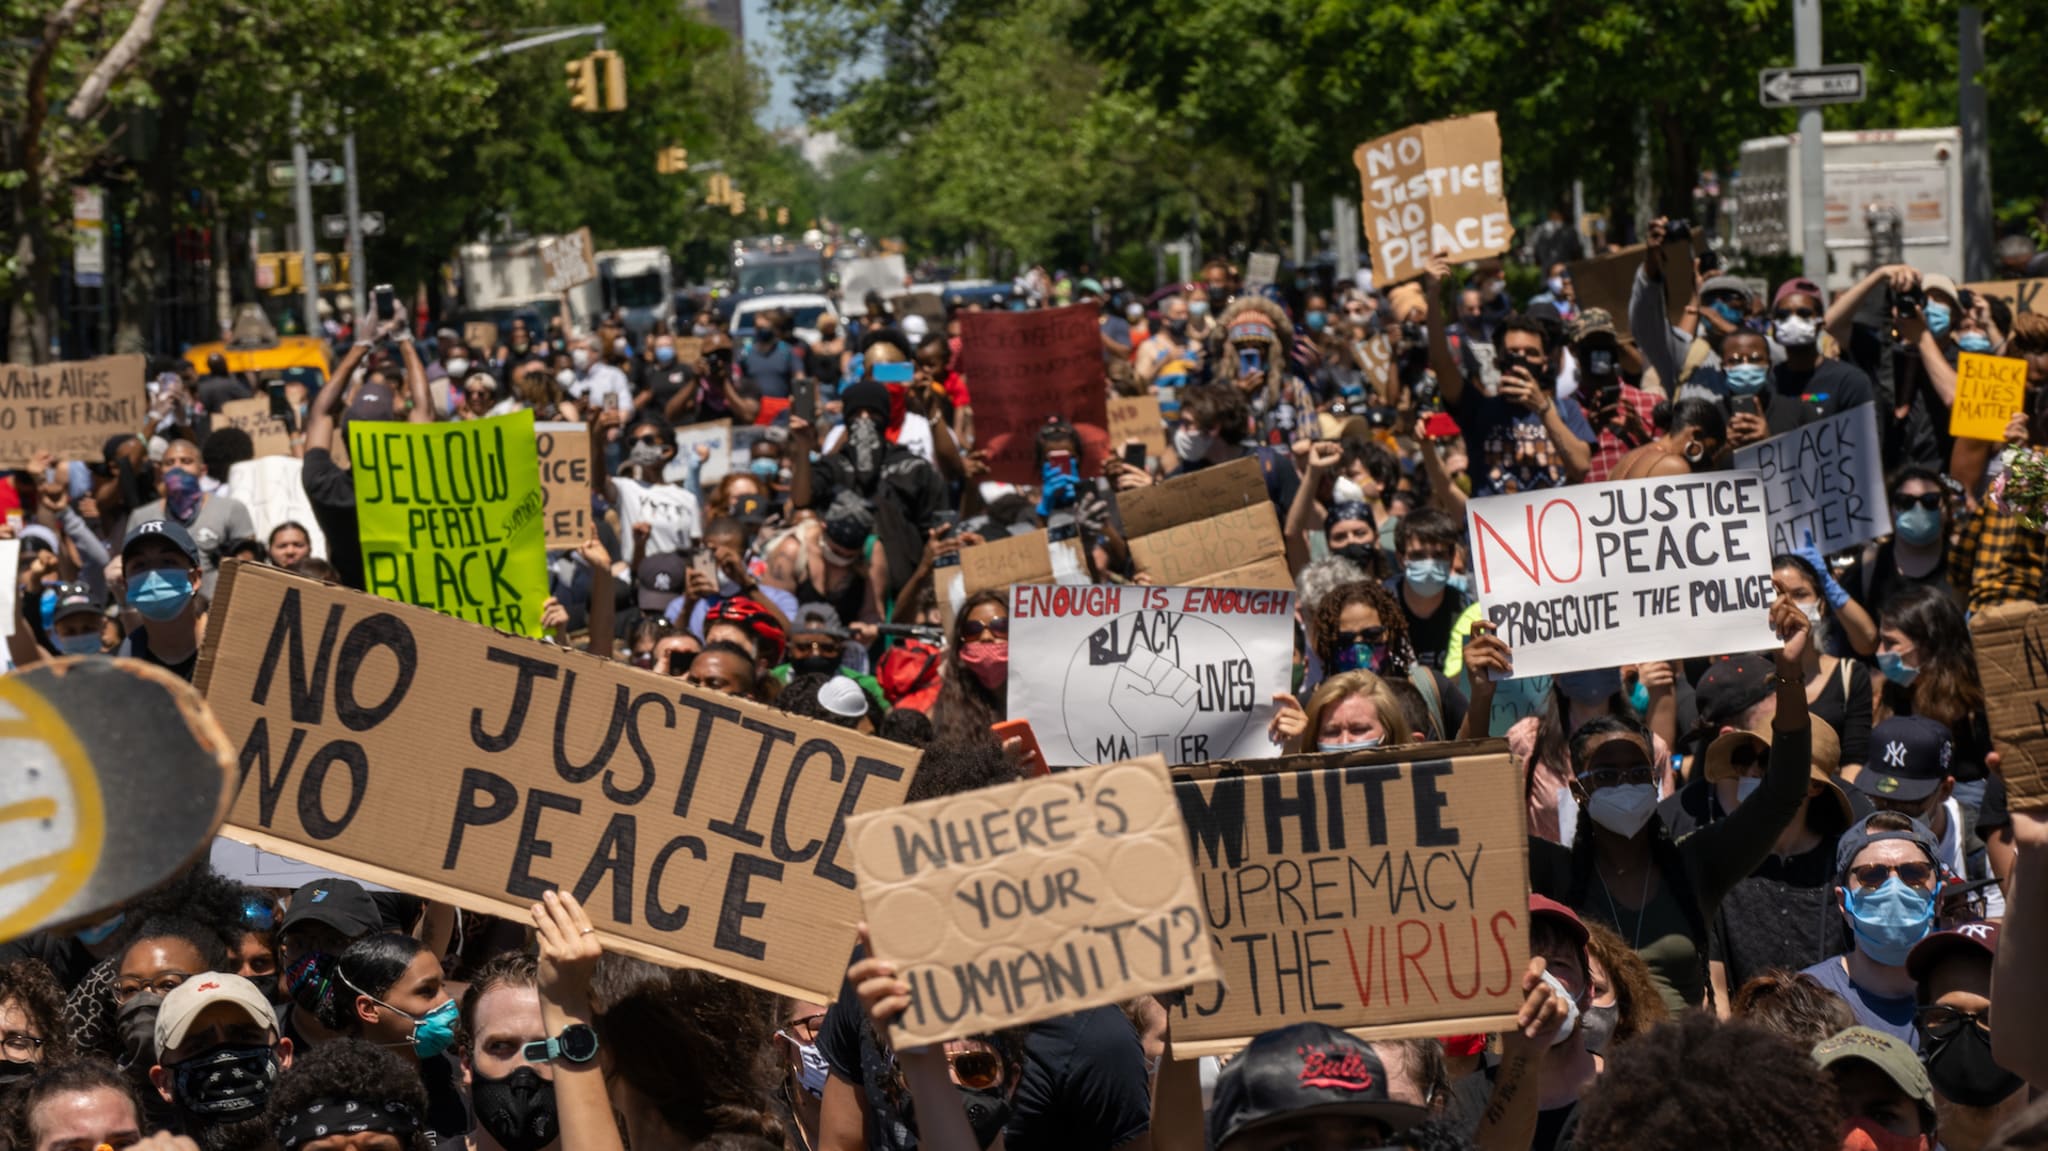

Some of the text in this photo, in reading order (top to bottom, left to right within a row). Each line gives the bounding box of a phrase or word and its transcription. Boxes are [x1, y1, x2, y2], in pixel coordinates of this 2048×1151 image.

[1366, 136, 1422, 177] NO
[1375, 203, 1425, 242] NO
[1380, 212, 1506, 280] PEACE
[58, 368, 111, 398] Allies
[1960, 379, 2016, 403] LIVES
[1965, 360, 2024, 385] BLACK
[0, 396, 138, 431] O THE FRONT!
[357, 426, 508, 506] YELLOW
[536, 433, 554, 458] O
[1758, 418, 1856, 482] BLACK
[1588, 478, 1761, 528] JUSTICE
[1764, 456, 1856, 515] LIVES
[408, 506, 502, 549] PERIL
[1472, 499, 1583, 594] NO
[1595, 520, 1751, 578] PEACE
[1769, 494, 1873, 557] ATTER
[368, 547, 522, 609] BLACK
[1014, 586, 1288, 618] ENOUGH IS ENOUGH
[1089, 610, 1184, 668] BLACK
[1488, 574, 1778, 648] PROSECUTE THE POLICE
[1196, 658, 1255, 713] LIVES
[250, 586, 905, 890] NO JUSTICE
[1883, 740, 1908, 767] NY
[238, 717, 786, 961] NO PEACE
[893, 782, 1128, 876] WHERE'S
[1173, 758, 1459, 868] WHITE
[956, 867, 1096, 929] YOUR
[1200, 844, 1483, 929] UPREMACY
[1231, 929, 1344, 1016] THE
[1343, 910, 1517, 1008] VIRUS
[1297, 1051, 1372, 1085] Bulls
